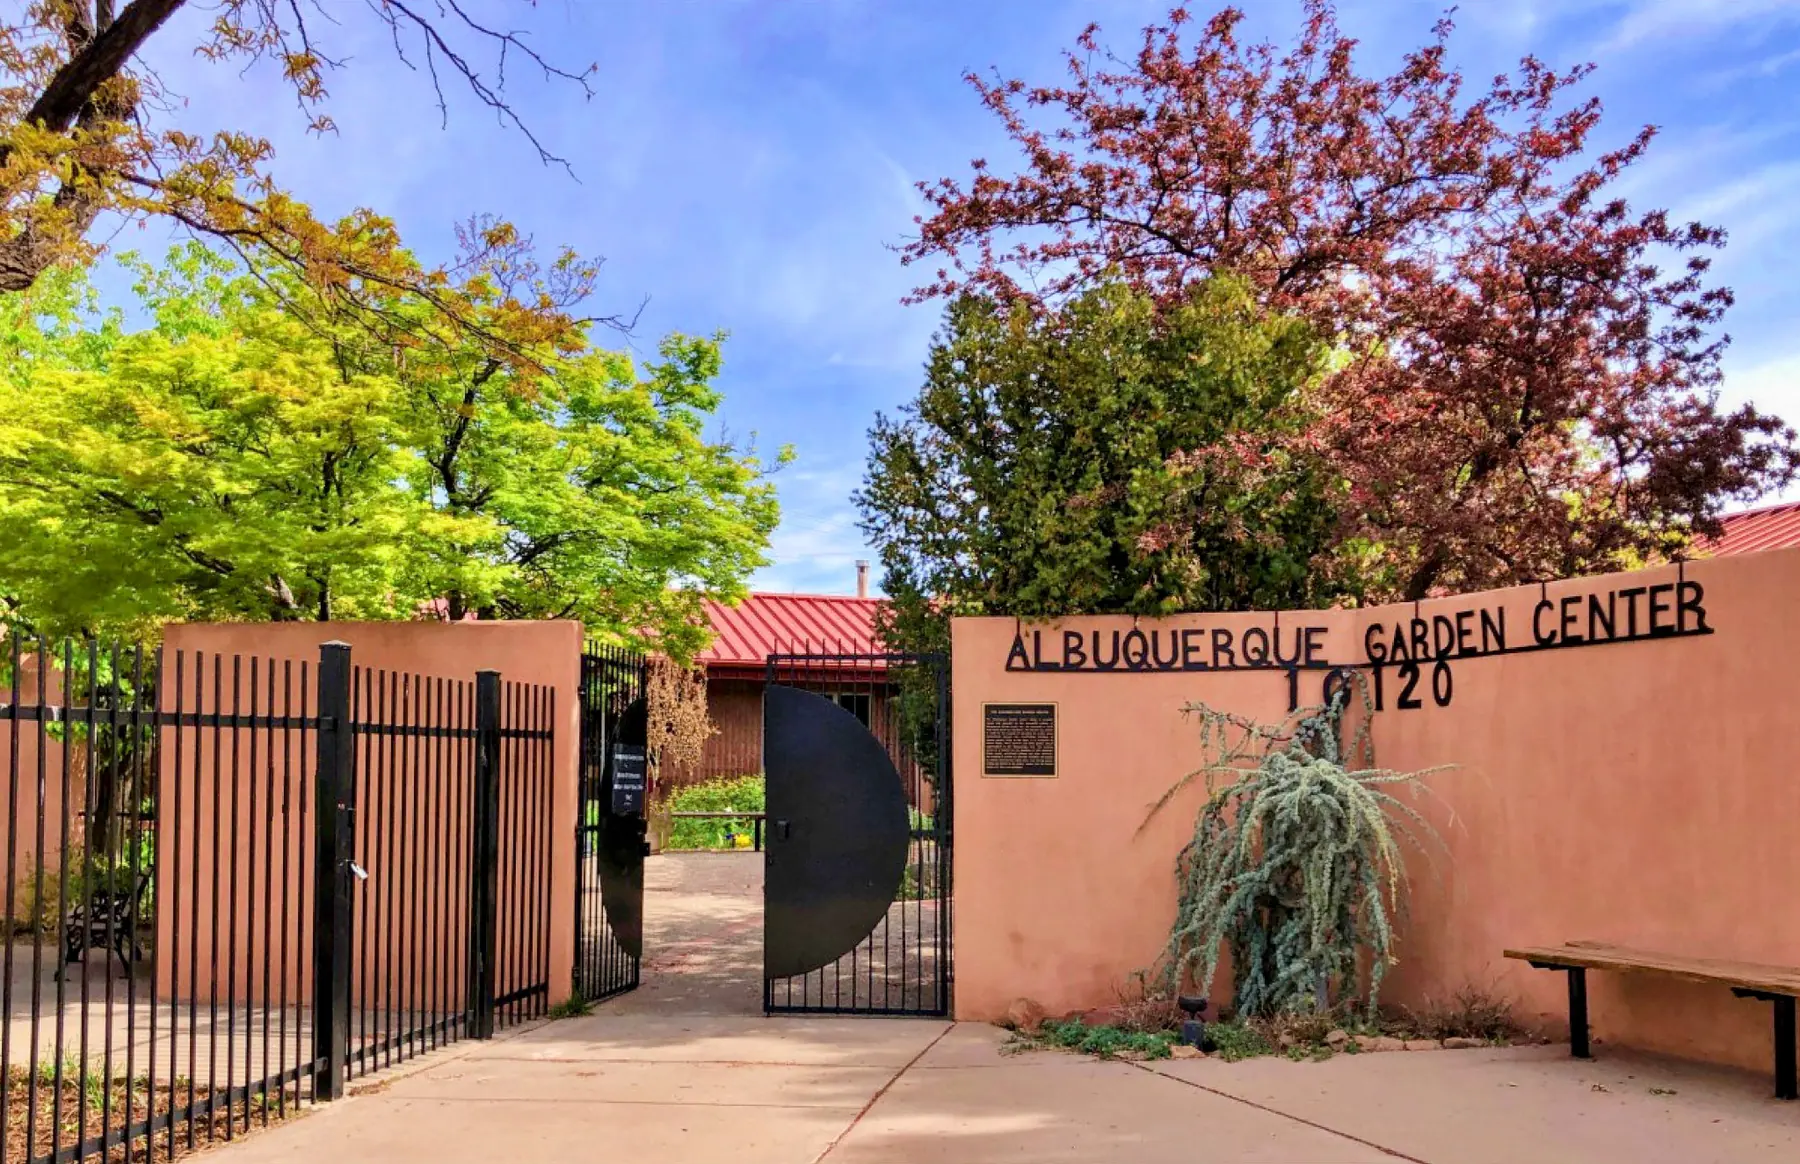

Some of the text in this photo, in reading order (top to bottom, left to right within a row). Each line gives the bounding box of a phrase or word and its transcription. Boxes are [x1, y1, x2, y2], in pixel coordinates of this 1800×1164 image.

[1006, 580, 1713, 670] ALBUQUERQUE GARDEN CENTER
